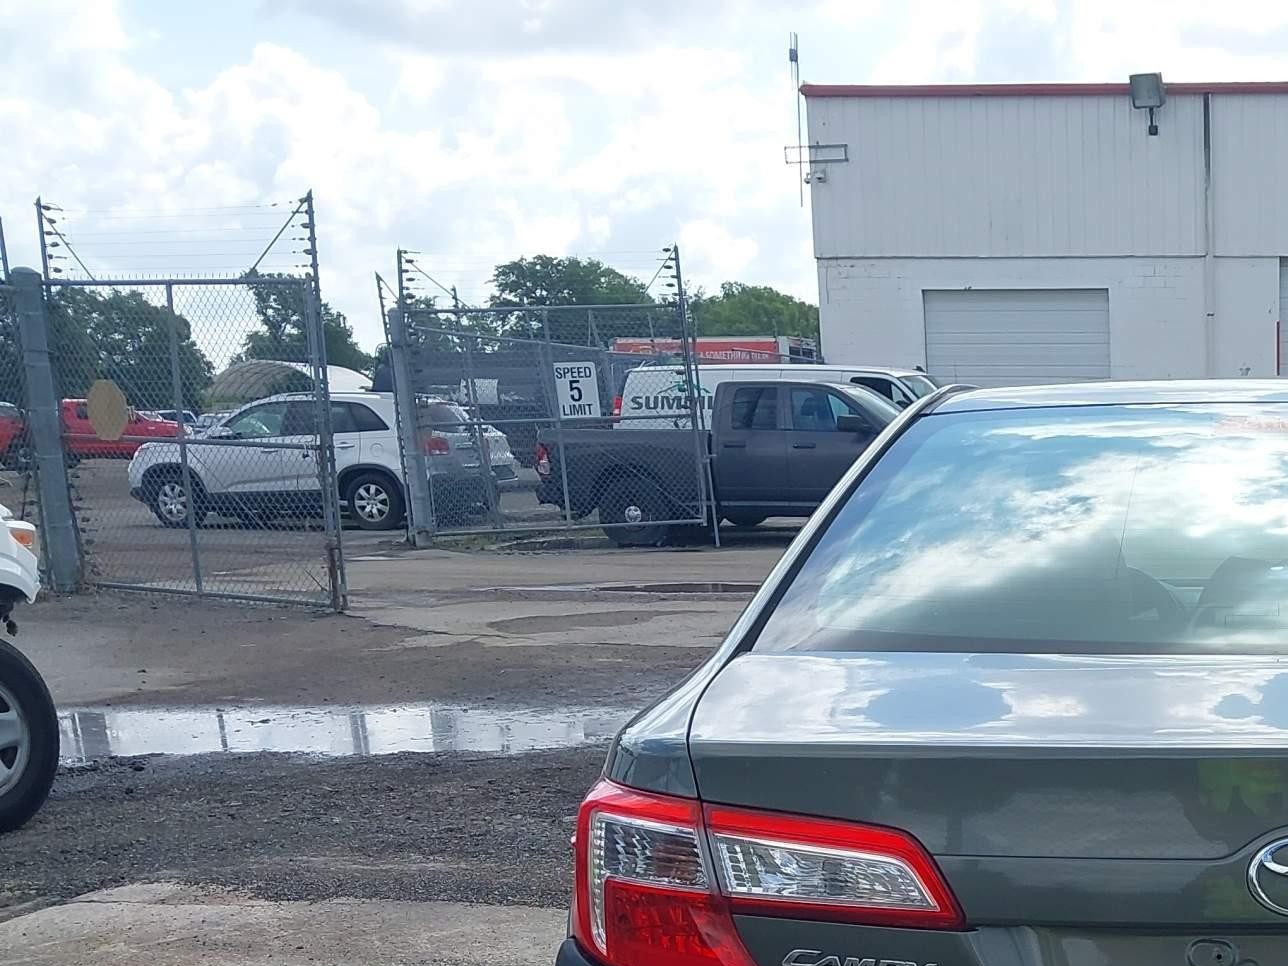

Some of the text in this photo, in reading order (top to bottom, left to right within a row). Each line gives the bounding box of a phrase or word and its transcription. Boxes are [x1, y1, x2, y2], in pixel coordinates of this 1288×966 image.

[555, 366, 592, 379] SPEED
[569, 379, 583, 402] 5
[562, 403, 593, 417] LIMIT
